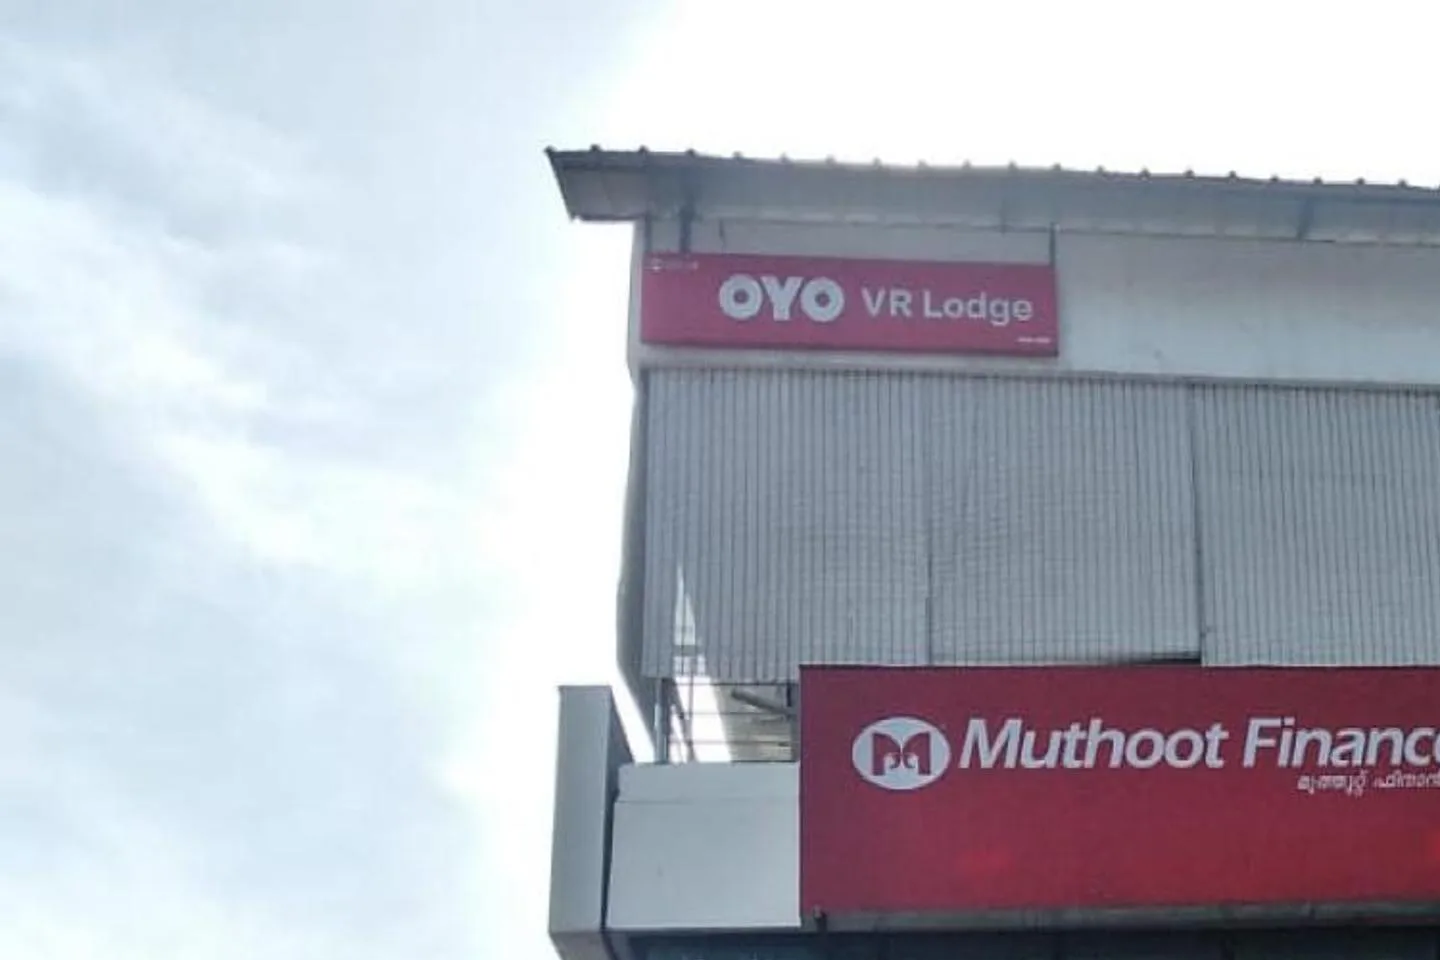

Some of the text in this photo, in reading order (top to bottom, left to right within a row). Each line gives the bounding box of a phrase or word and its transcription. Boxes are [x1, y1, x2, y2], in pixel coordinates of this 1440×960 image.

[719, 274, 1034, 327] OYO VR Lodge
[959, 717, 1228, 769] Muthoot
